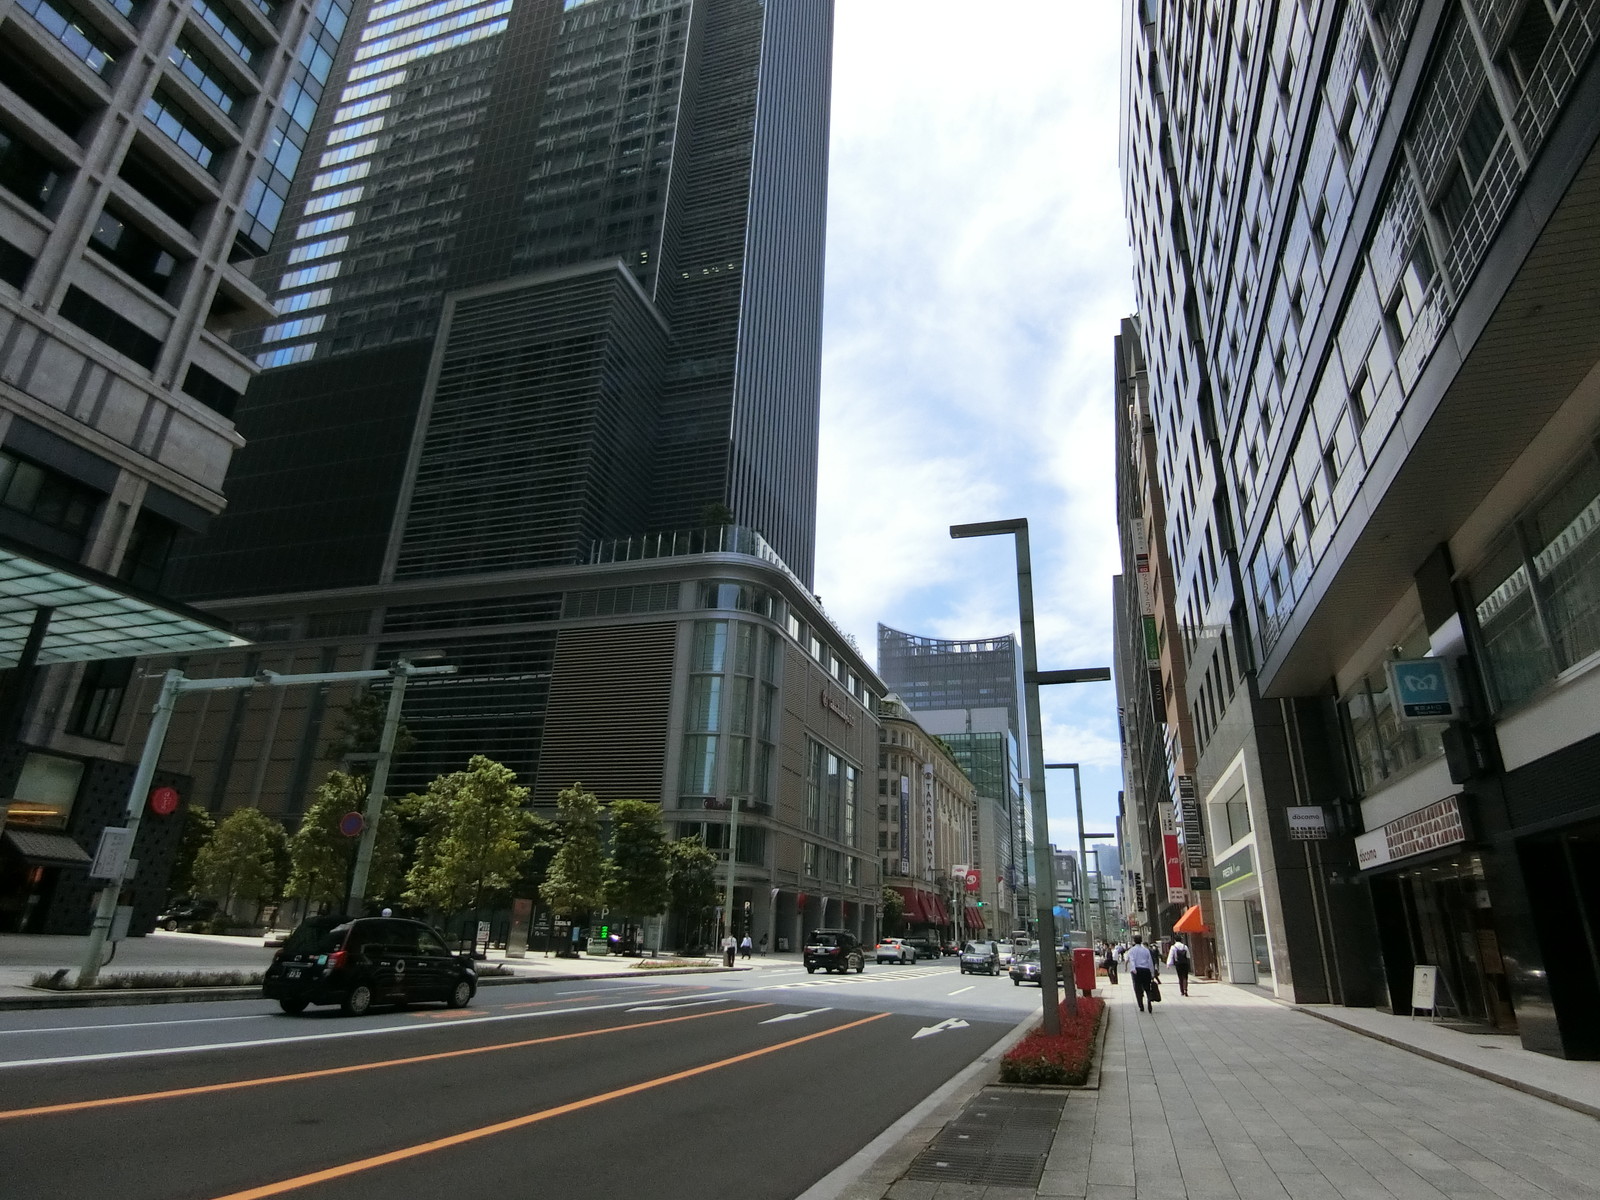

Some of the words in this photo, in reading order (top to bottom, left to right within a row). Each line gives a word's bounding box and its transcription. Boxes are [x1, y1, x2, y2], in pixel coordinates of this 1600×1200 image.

[1359, 849, 1377, 863] docomo
[1134, 872, 1144, 913] MARUZEN
[600, 907, 610, 920] P
